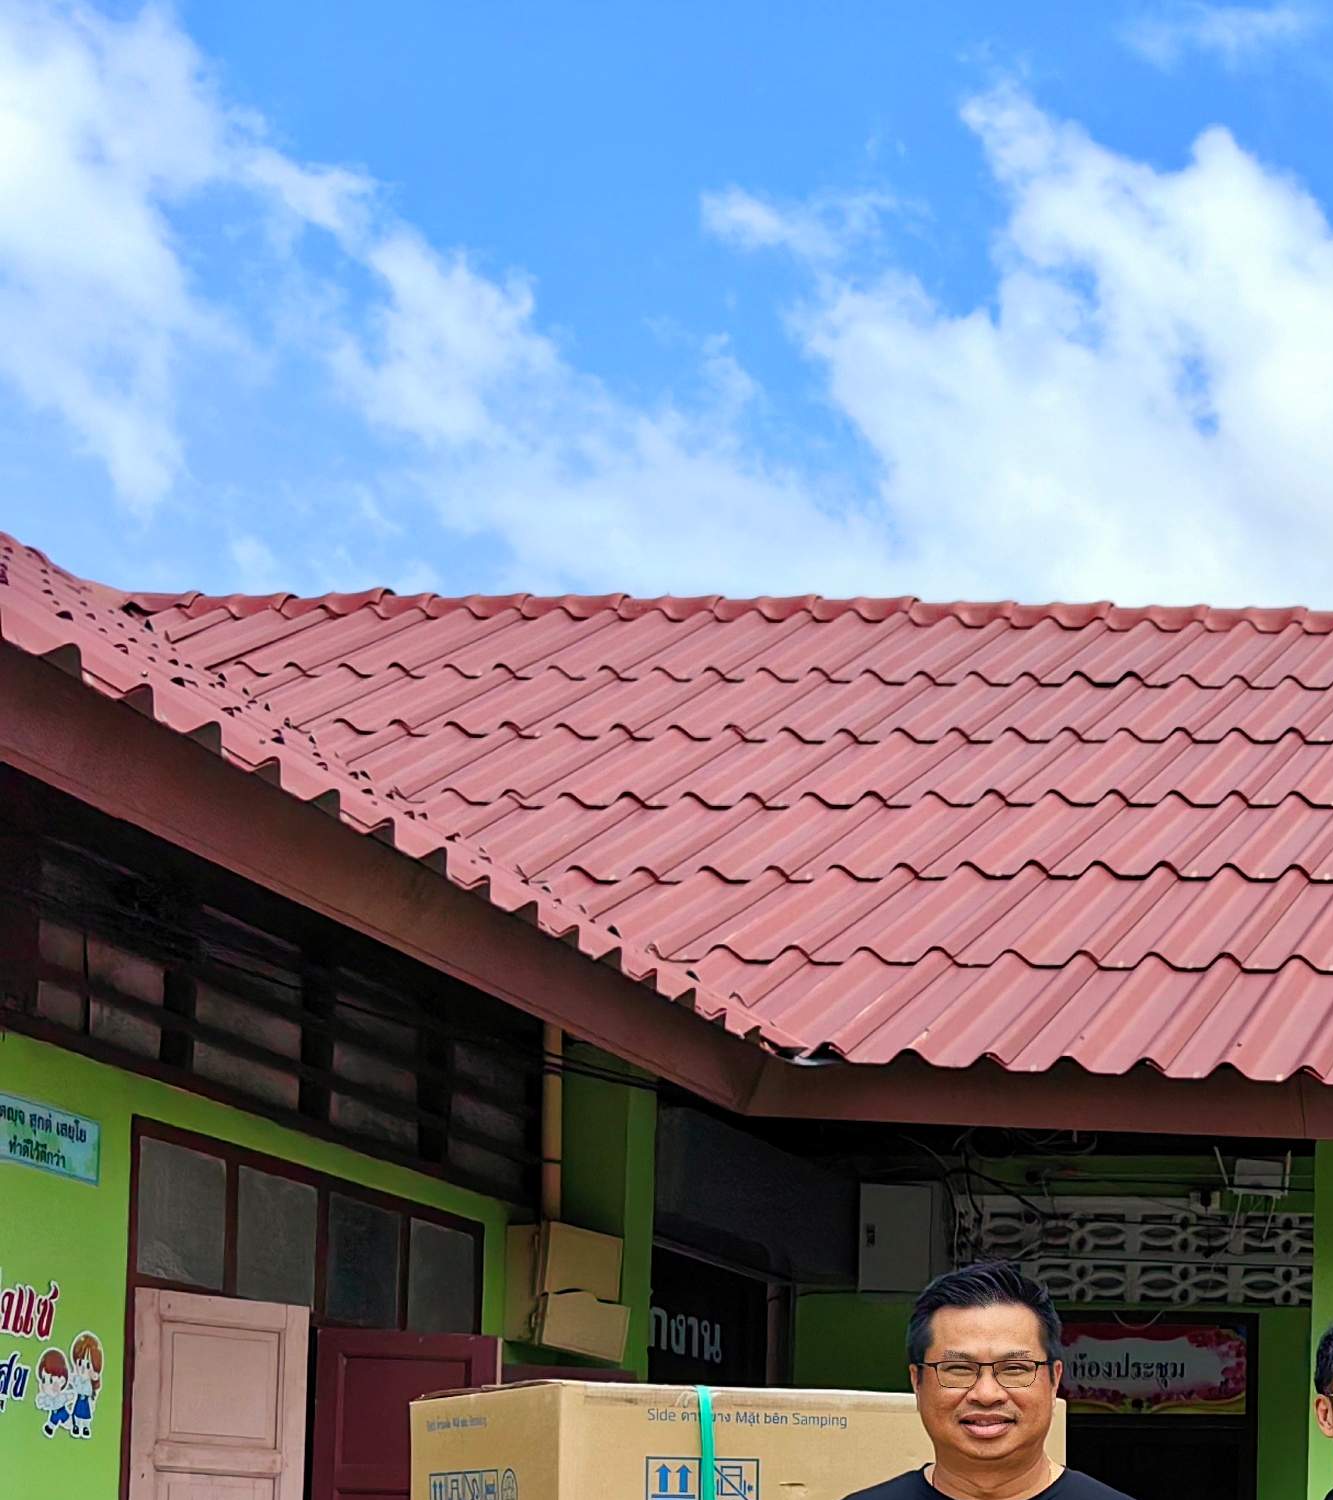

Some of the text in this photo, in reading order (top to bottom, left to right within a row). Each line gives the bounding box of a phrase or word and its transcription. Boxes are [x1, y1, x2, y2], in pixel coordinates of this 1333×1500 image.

[650, 1306, 722, 1364] กงาน
[1072, 1352, 1185, 1388] ห้องประชุม
[648, 1408, 676, 1422] Side
[764, 1410, 788, 1425] bên
[792, 1412, 848, 1428] Samping
